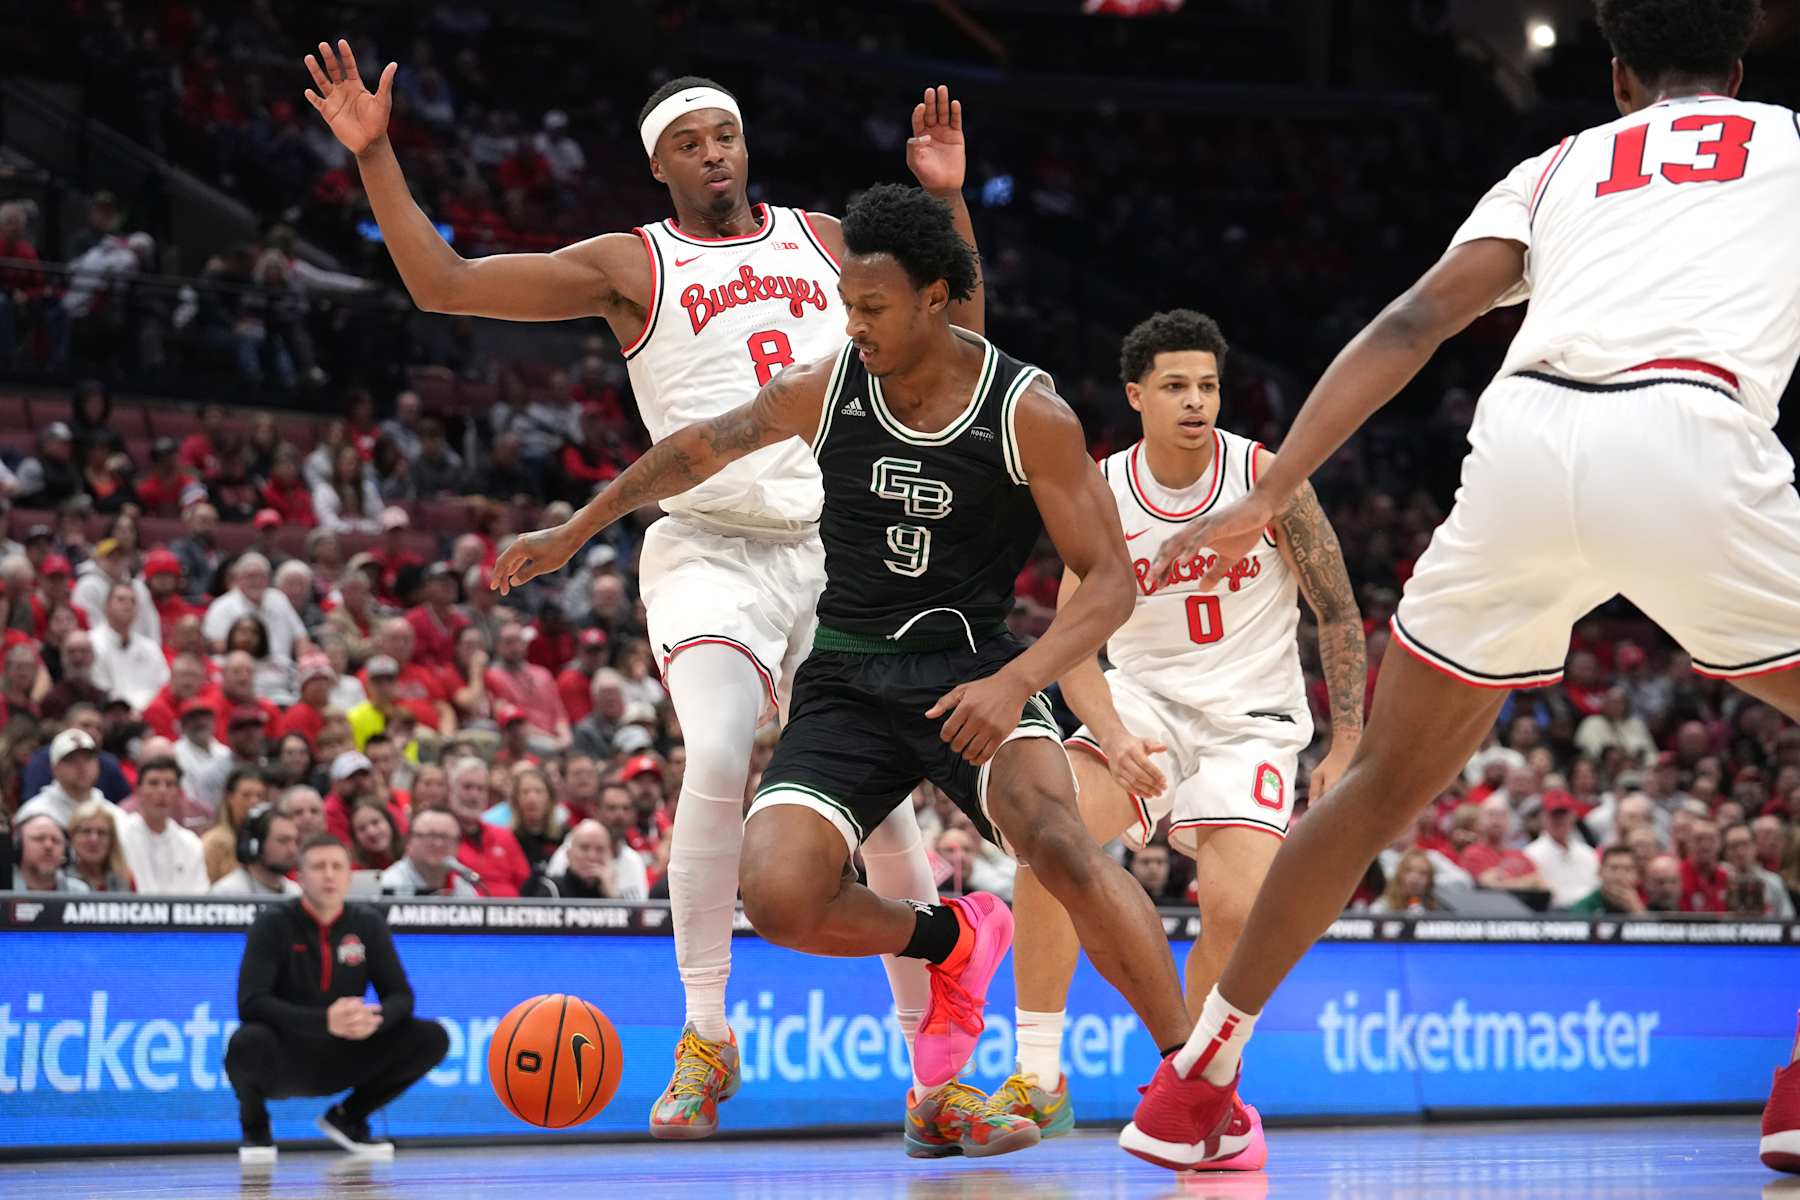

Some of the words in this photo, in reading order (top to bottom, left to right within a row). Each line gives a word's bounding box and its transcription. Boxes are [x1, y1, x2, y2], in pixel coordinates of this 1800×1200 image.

[1595, 114, 1756, 198] 13
[680, 265, 828, 336] Buckeyes
[747, 329, 796, 388] 8
[841, 408, 866, 417] adidas
[870, 456, 953, 519] GB
[883, 523, 932, 578] 9
[62, 904, 170, 924] AMERICAN
[172, 904, 257, 924] ELECTRIC
[387, 905, 483, 925] AMERICAN
[486, 906, 563, 926] ELECTRIC
[565, 907, 629, 927] POWER
[1317, 989, 1660, 1073] ticketmaster
